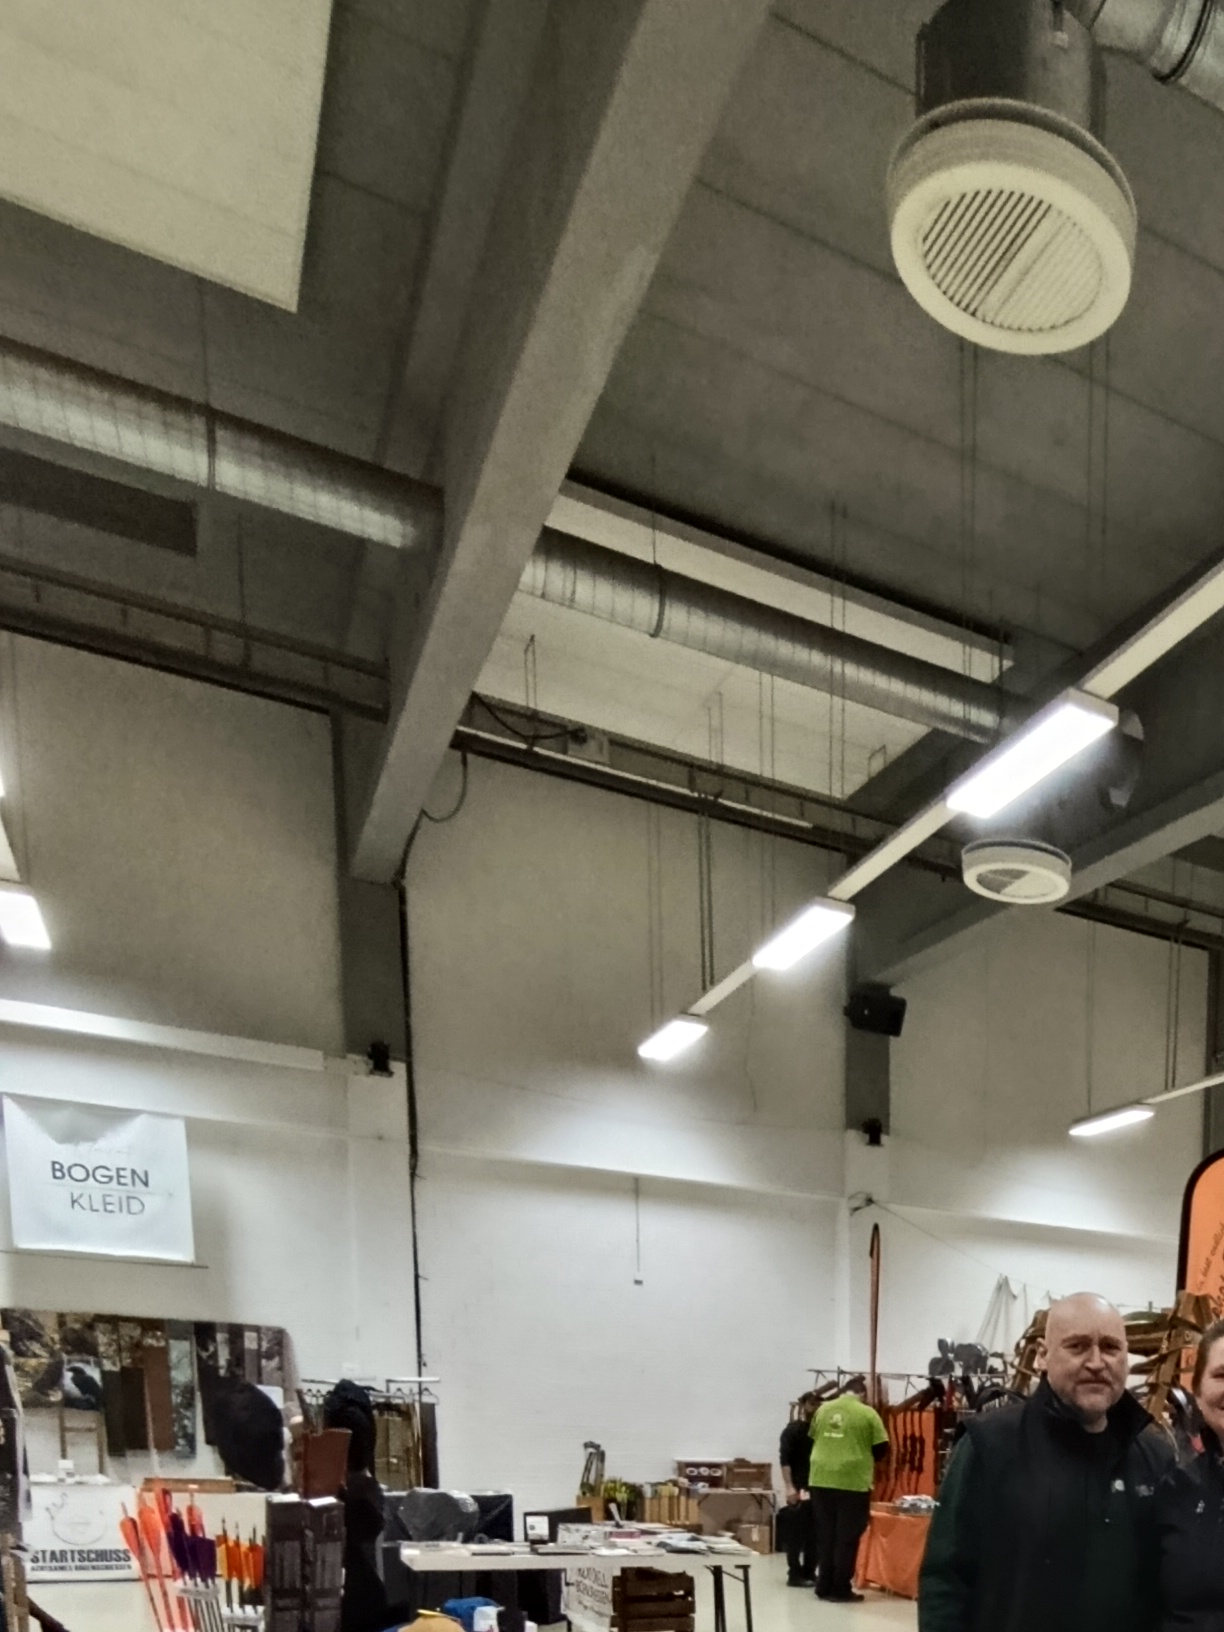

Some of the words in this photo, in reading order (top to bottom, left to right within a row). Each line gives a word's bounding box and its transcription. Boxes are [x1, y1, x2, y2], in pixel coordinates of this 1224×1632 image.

[51, 1160, 150, 1188] BOGEN
[70, 1191, 146, 1216] KLEID
[30, 1549, 131, 1564] STARTSCHUSS
